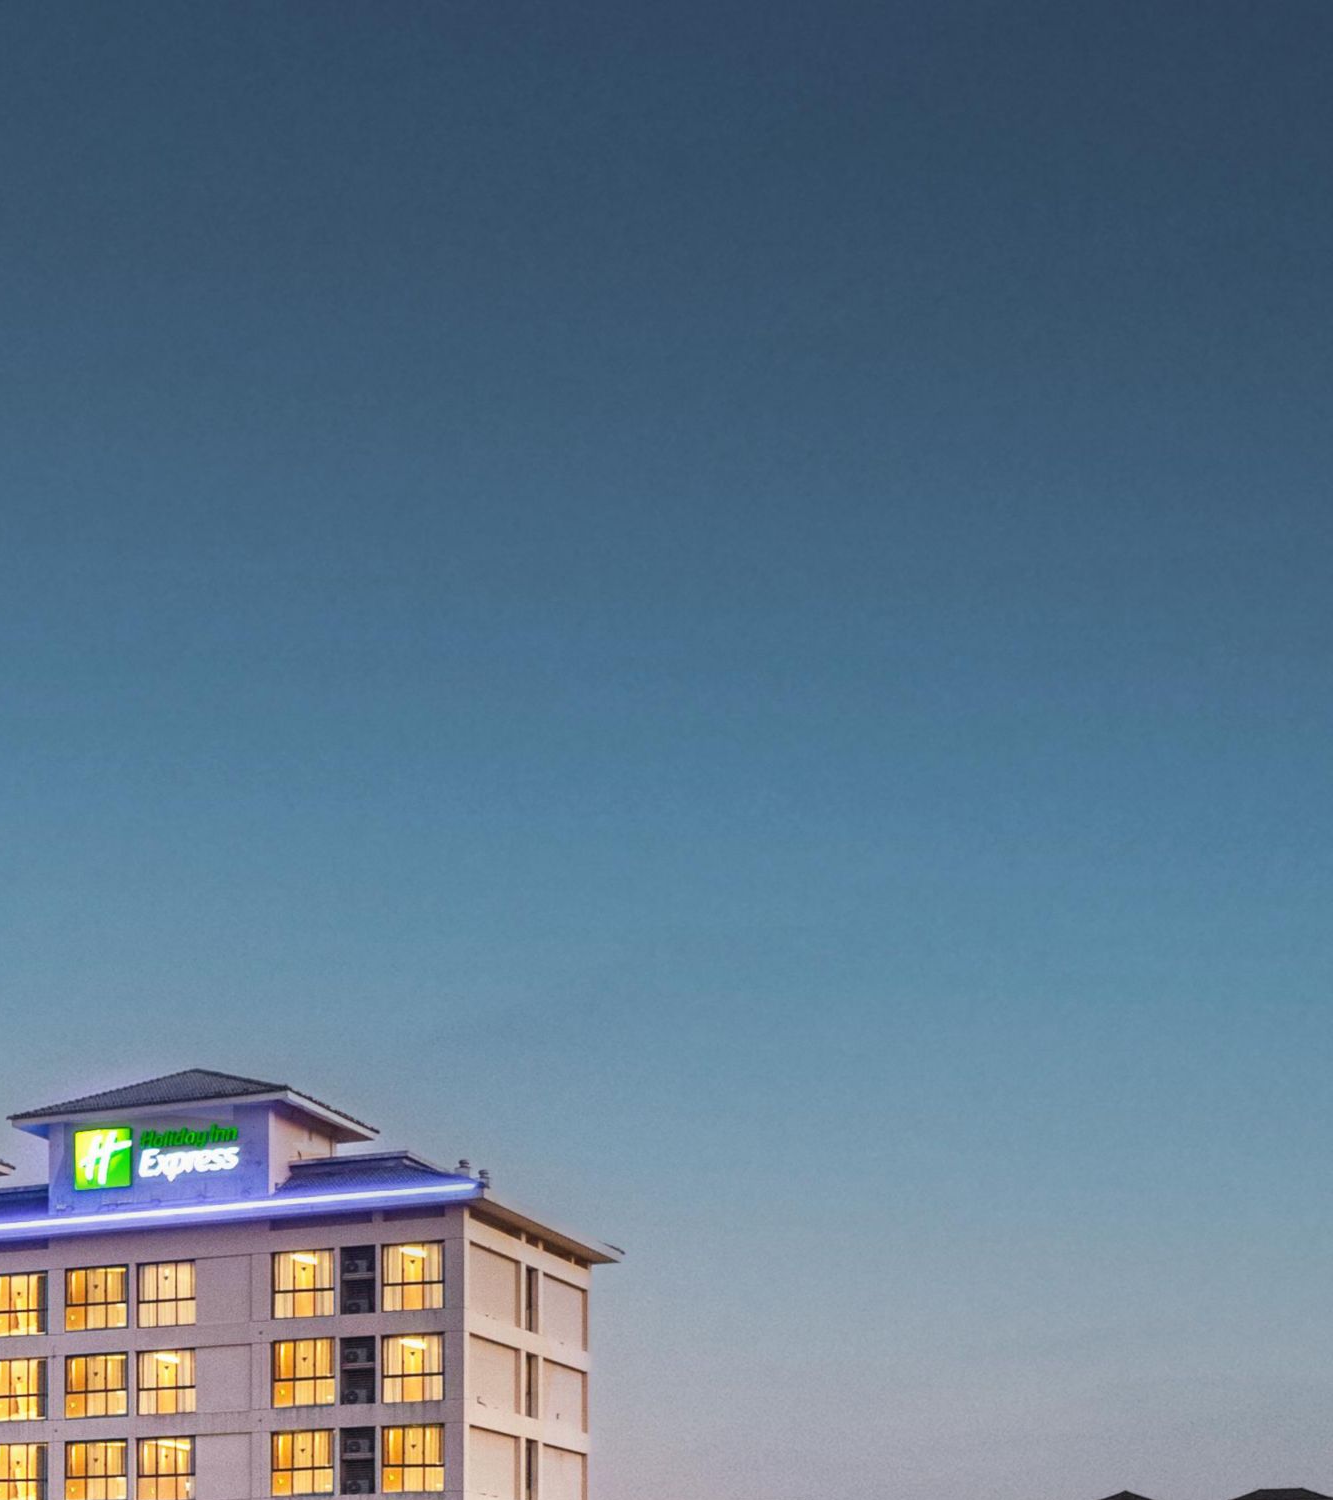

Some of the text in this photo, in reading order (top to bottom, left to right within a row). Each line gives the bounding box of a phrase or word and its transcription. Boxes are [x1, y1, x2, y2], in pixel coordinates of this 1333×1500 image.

[139, 1123, 239, 1148] Holiday Inn
[138, 1146, 241, 1182] Express
